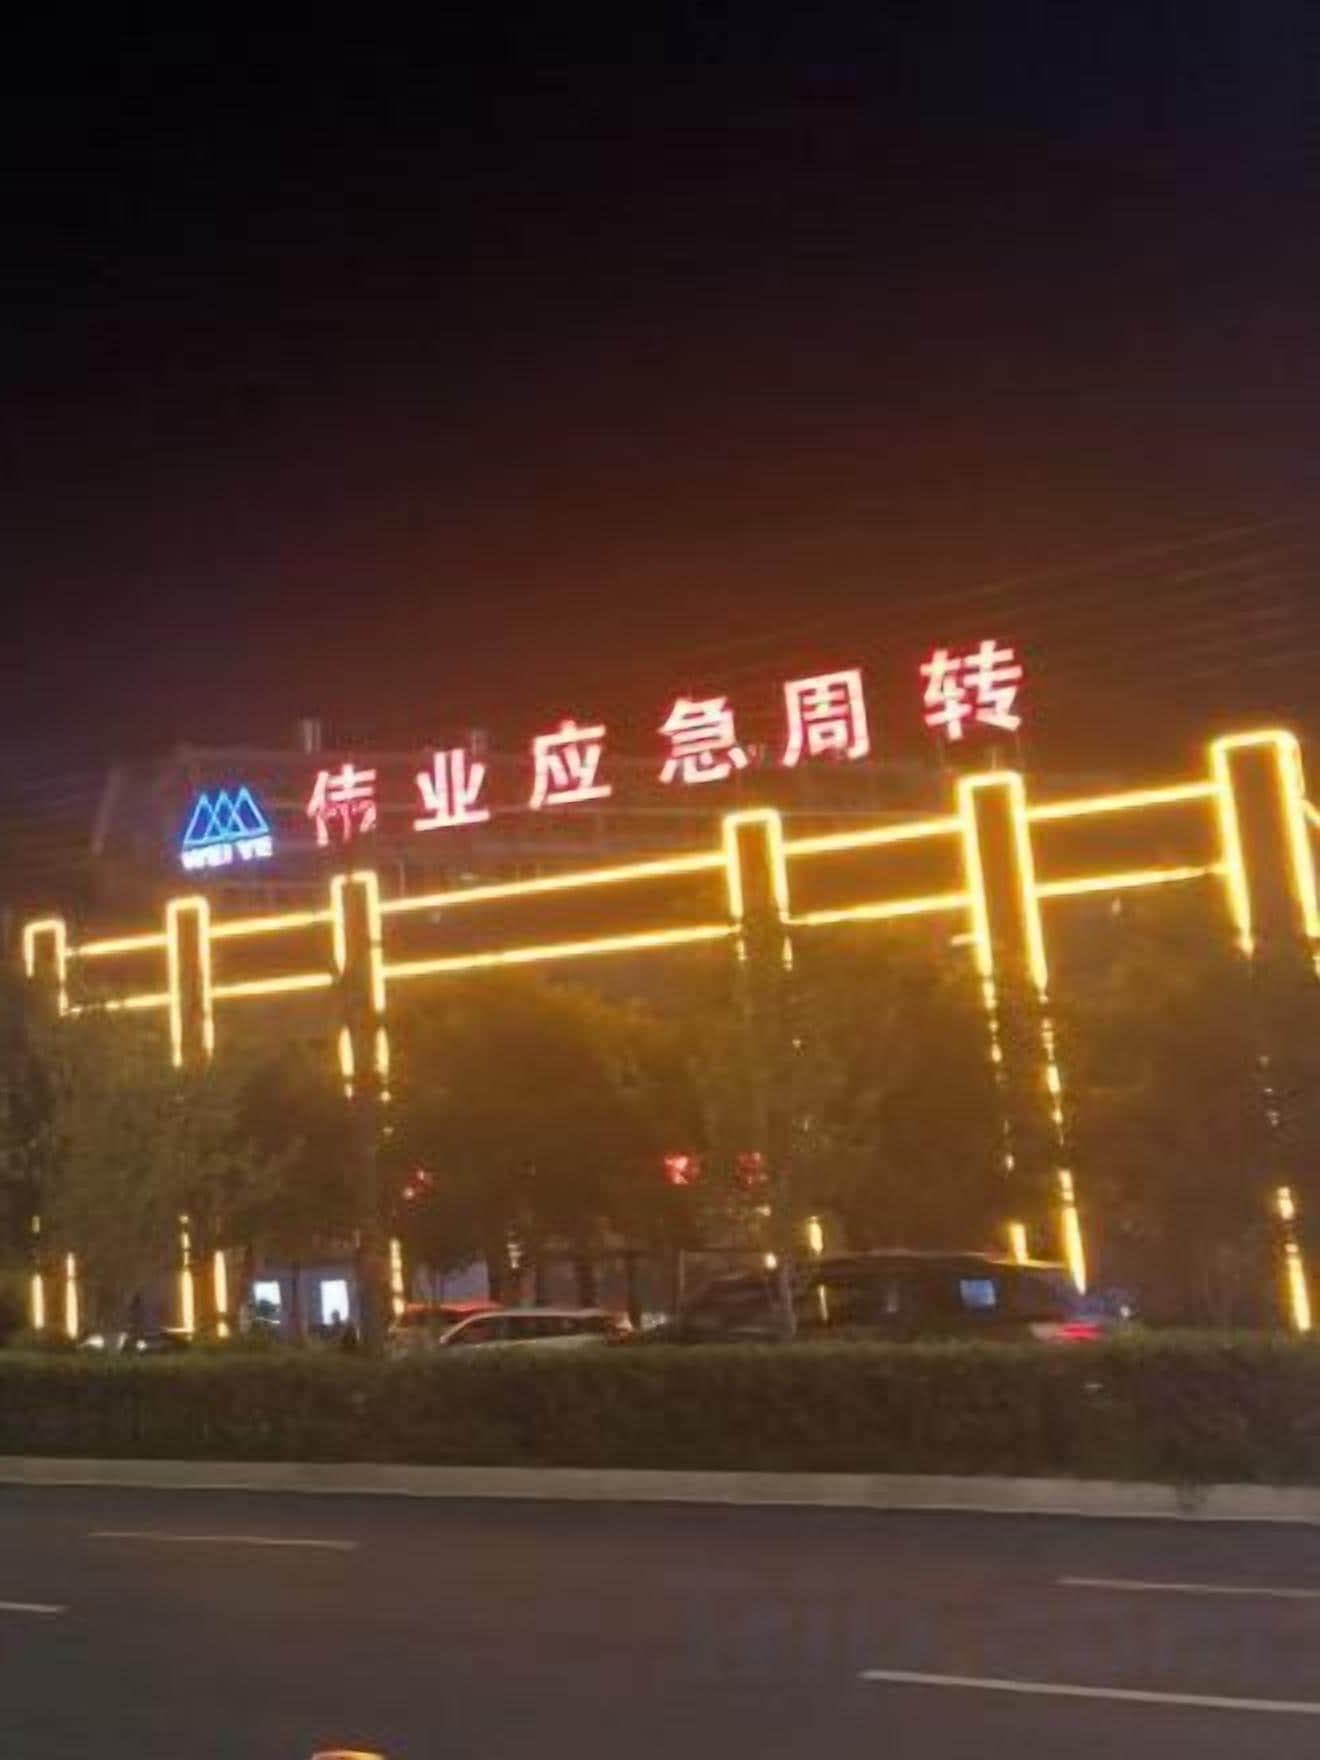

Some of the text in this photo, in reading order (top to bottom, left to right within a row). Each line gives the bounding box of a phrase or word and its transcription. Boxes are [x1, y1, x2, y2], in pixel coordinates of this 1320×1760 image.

[306, 638, 1024, 848] 伟业应急周转
